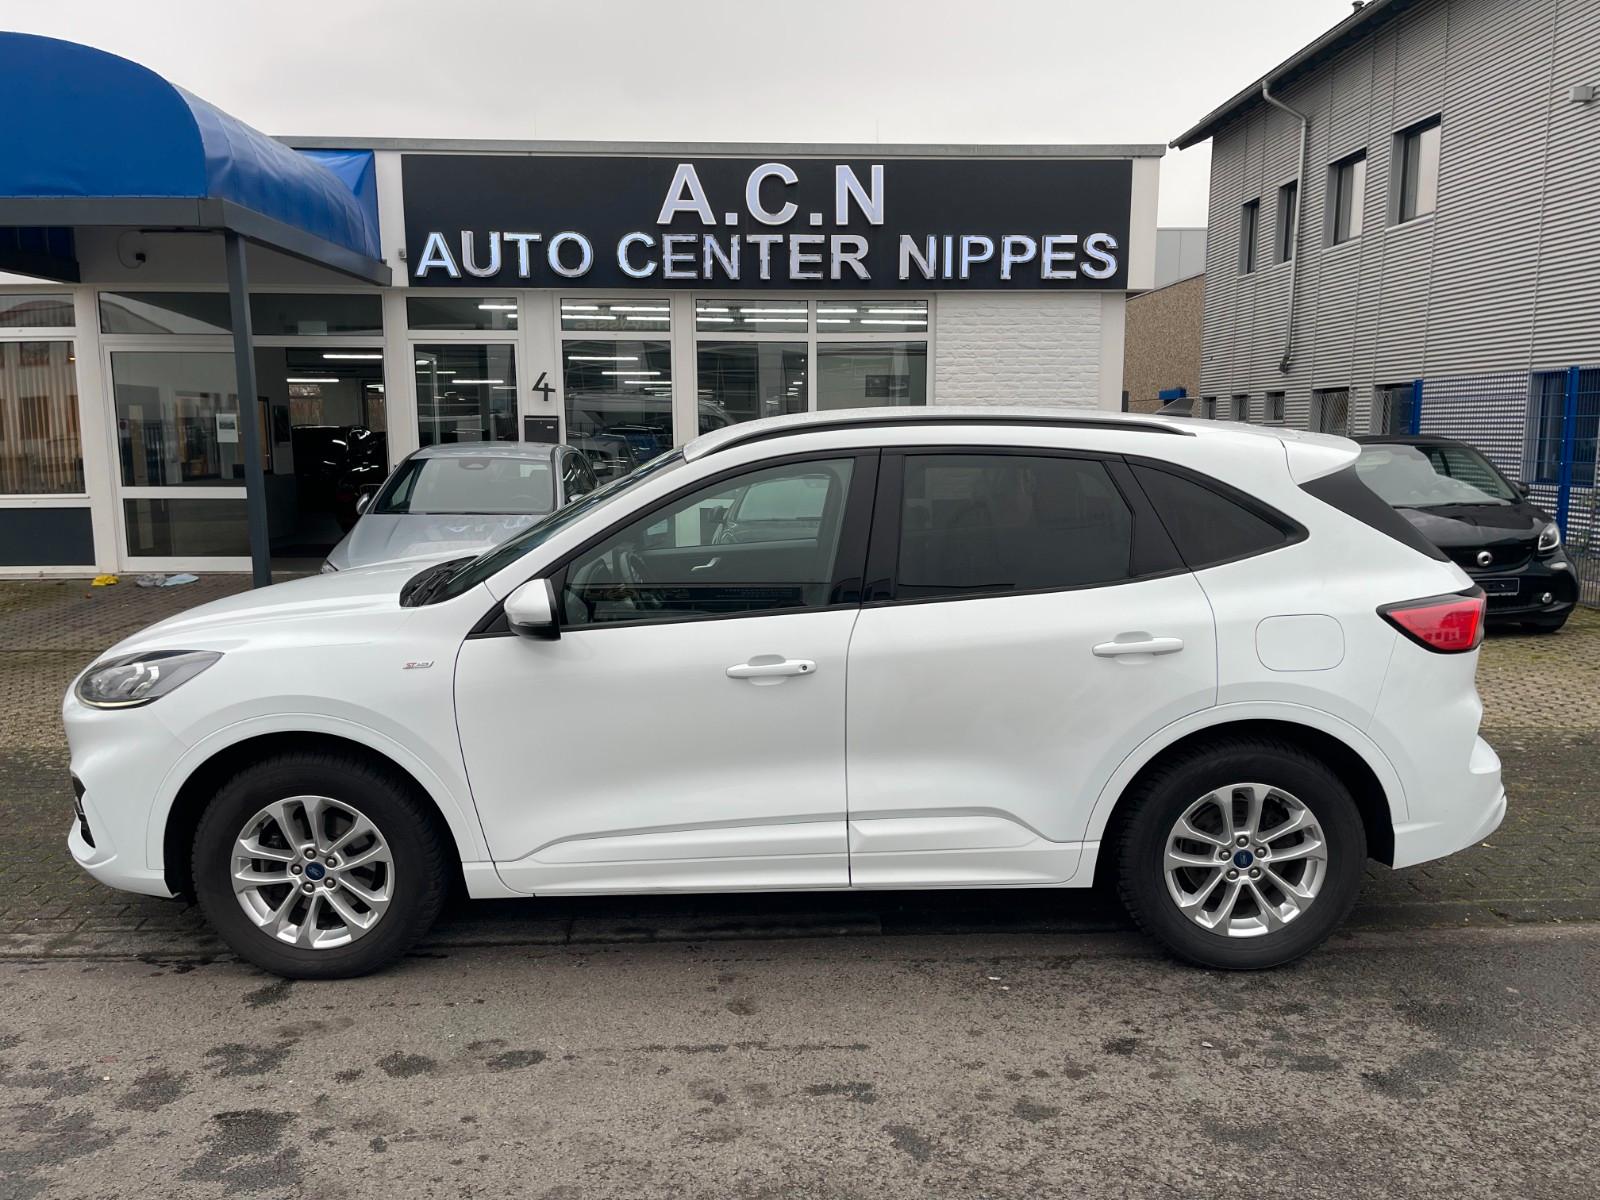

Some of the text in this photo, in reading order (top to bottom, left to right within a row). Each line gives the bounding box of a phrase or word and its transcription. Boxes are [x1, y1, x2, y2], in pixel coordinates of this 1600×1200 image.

[656, 163, 885, 226] A.C.N
[414, 230, 1119, 280] AUTO CENTER NIPPES
[532, 371, 556, 402] 4
